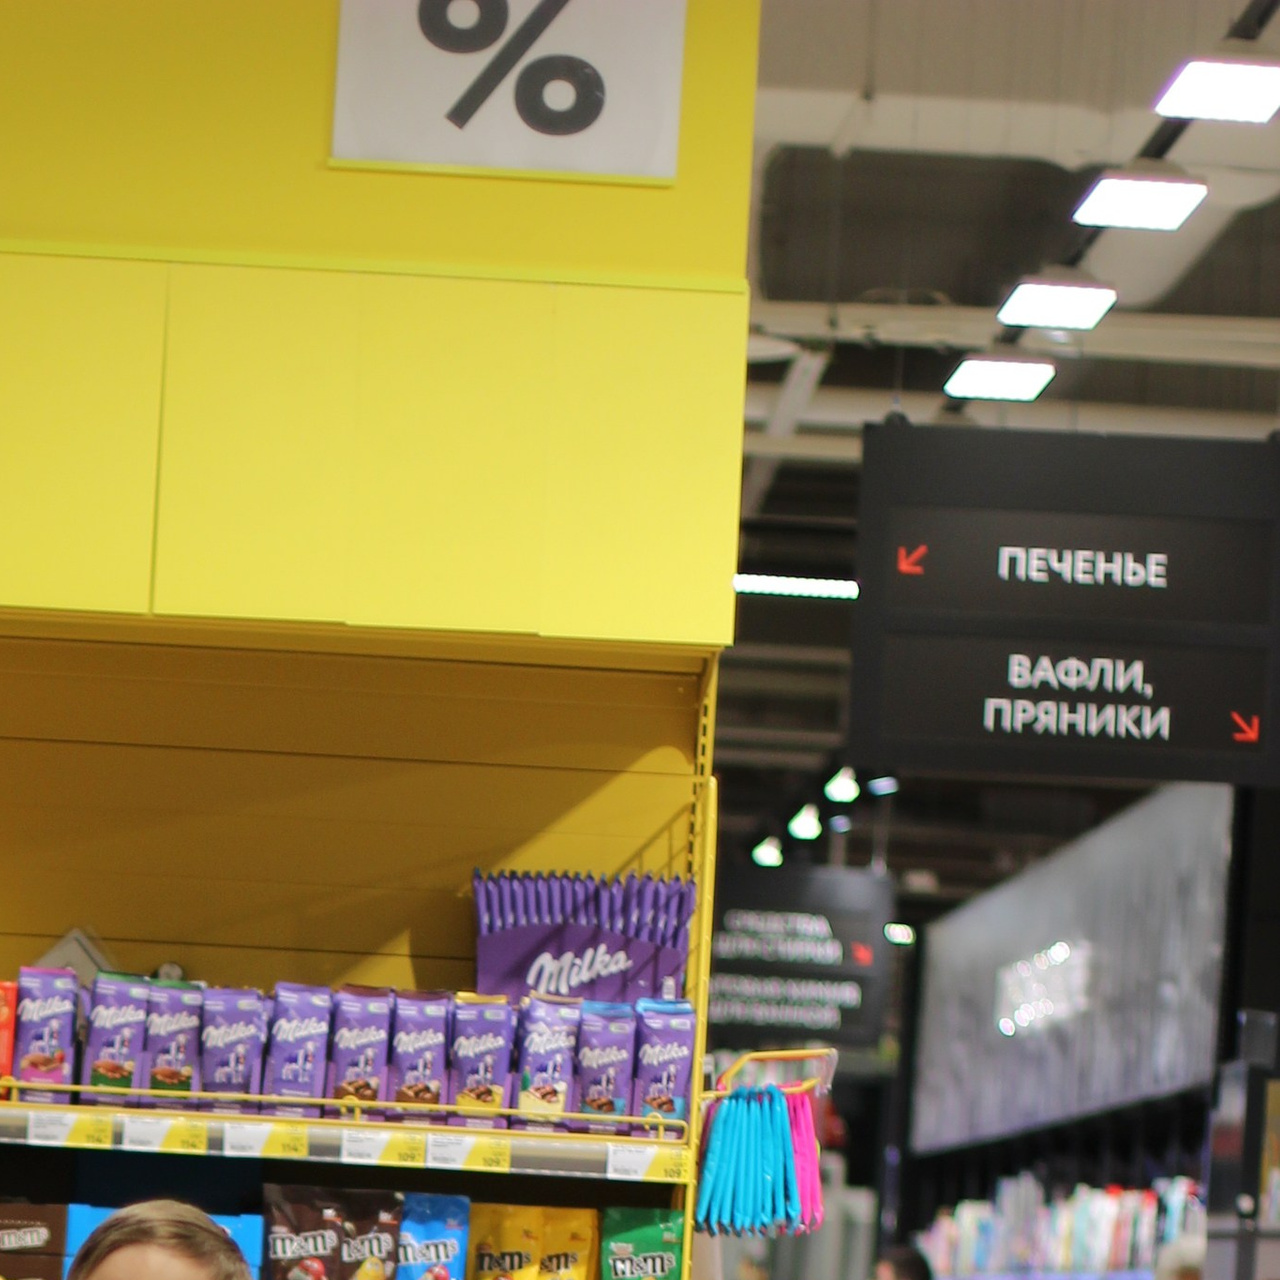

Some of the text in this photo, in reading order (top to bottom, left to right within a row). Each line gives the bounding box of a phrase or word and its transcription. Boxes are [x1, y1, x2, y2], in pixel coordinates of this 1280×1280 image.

[997, 546, 1168, 588] ПЕЧЕНЬЕ
[1007, 653, 1154, 699] ВАФЛИ,
[983, 697, 1171, 741] ПРЯНИКИ
[526, 943, 633, 995] Milka
[17, 996, 75, 1021] Milka
[91, 1004, 147, 1028] Milka
[146, 1011, 199, 1036] Milka
[202, 1021, 257, 1047] Milka
[272, 1017, 329, 1042] Milka
[334, 1026, 387, 1049] Milka
[393, 1028, 446, 1053] Milka
[454, 1033, 506, 1057] Milka
[524, 1030, 577, 1054] Milka
[578, 1045, 629, 1068] Milka
[638, 1042, 689, 1065] Milka
[663, 1167, 682, 1179] 109
